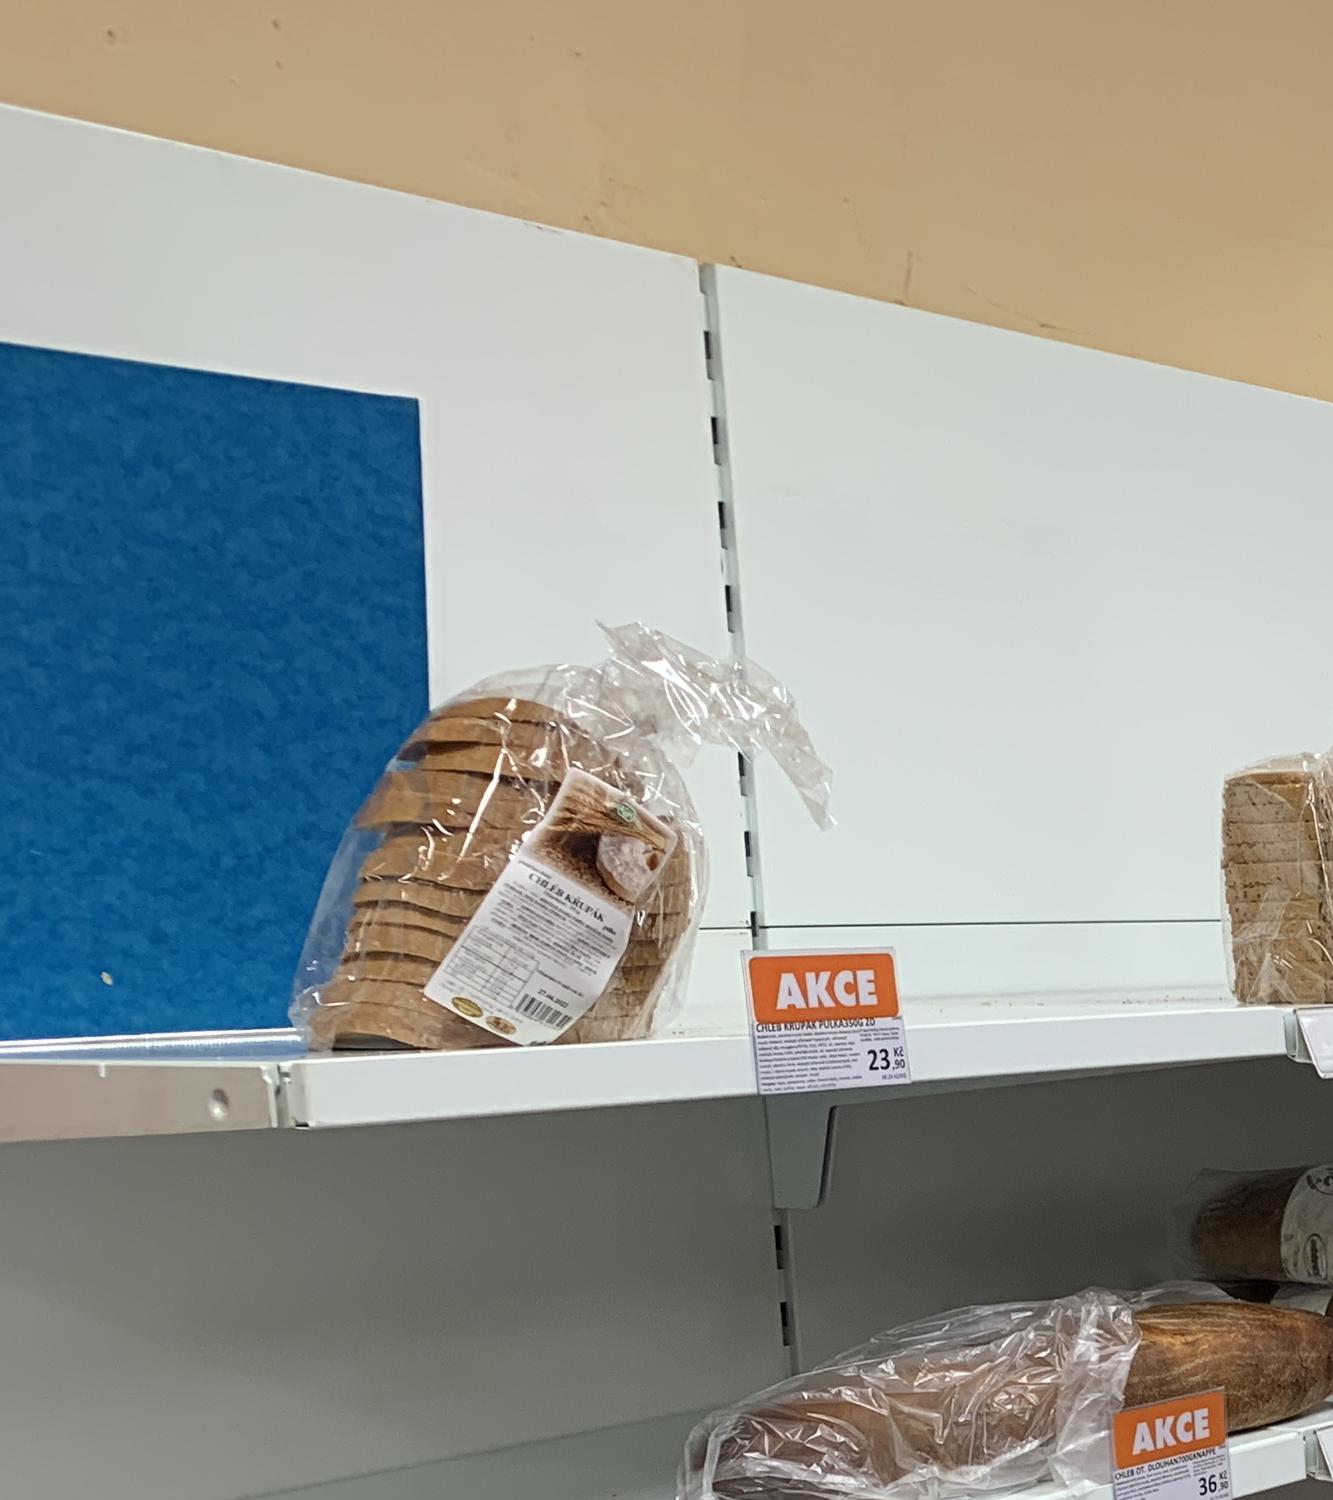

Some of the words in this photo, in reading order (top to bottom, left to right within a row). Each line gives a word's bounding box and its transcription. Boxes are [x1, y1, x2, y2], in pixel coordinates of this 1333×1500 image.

[776, 969, 878, 1010] AKCE
[867, 1049, 891, 1071] 23
[1132, 1408, 1210, 1456] AKCE
[1198, 1475, 1217, 1496] 36
